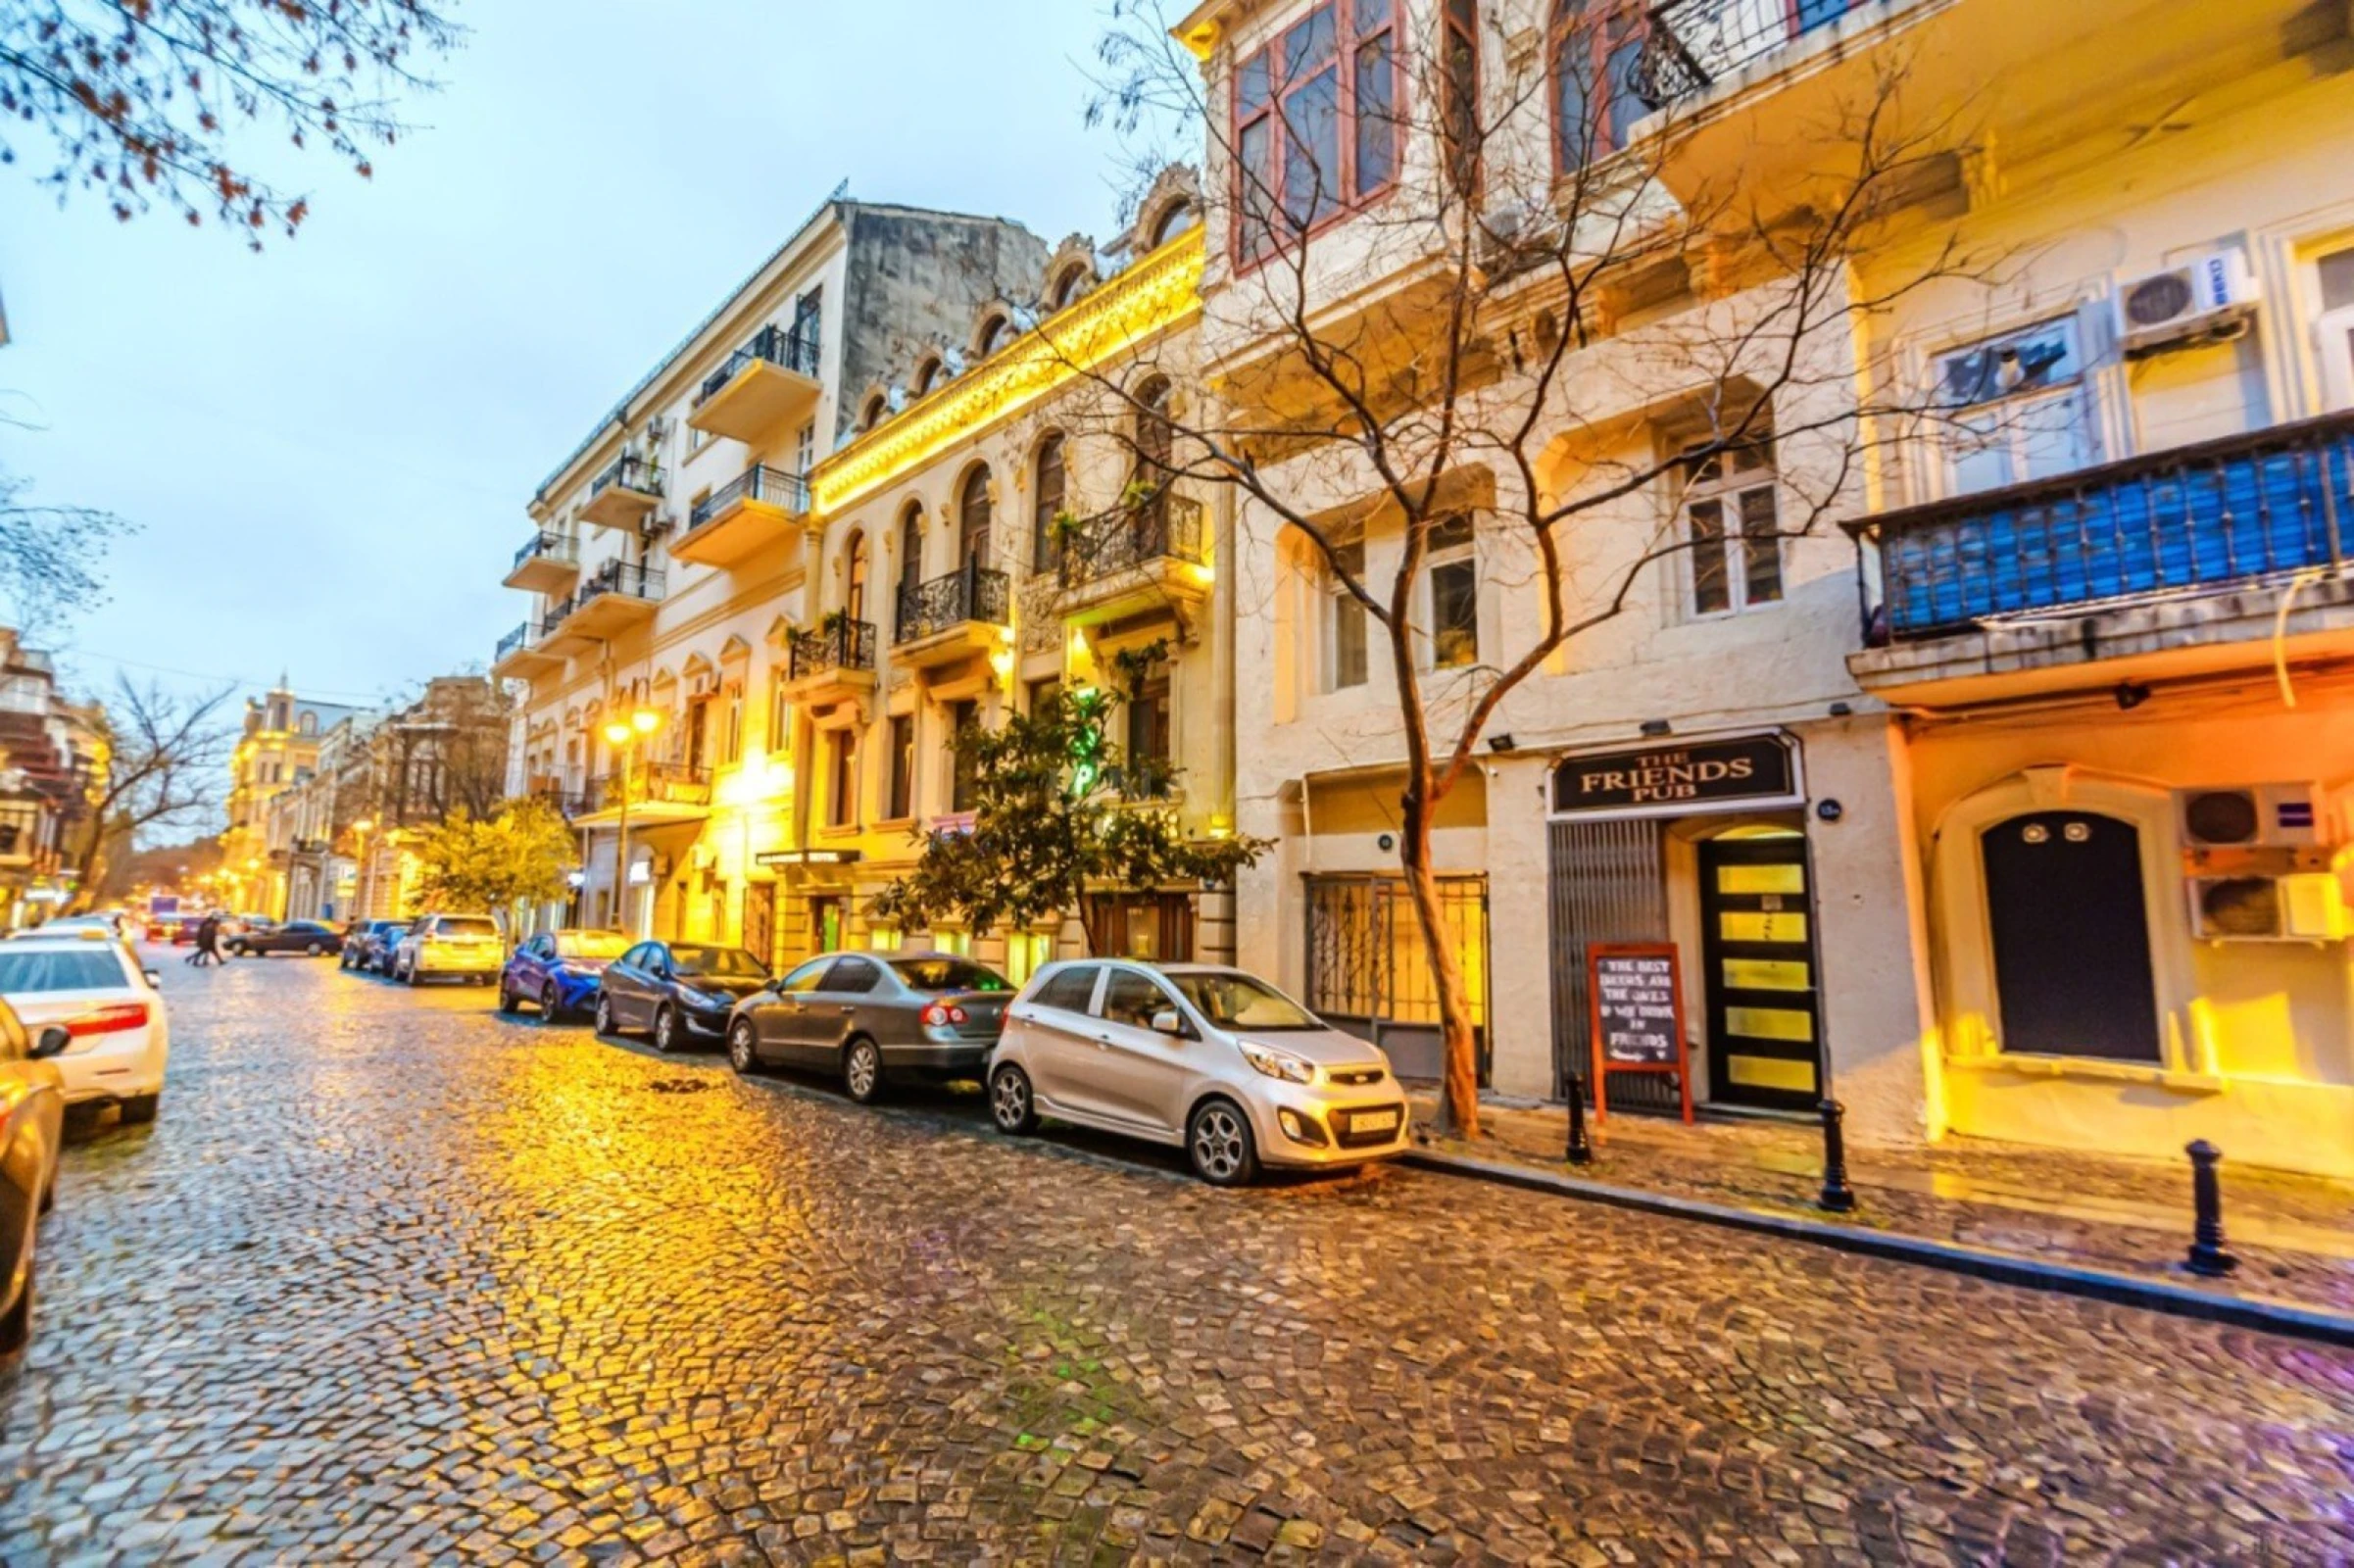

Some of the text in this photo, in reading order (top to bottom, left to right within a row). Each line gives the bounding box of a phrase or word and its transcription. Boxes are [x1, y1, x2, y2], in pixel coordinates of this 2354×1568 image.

[1638, 752, 1689, 767] THE
[1581, 758, 1753, 793] FRIENDS
[1634, 785, 1696, 802] PUB
